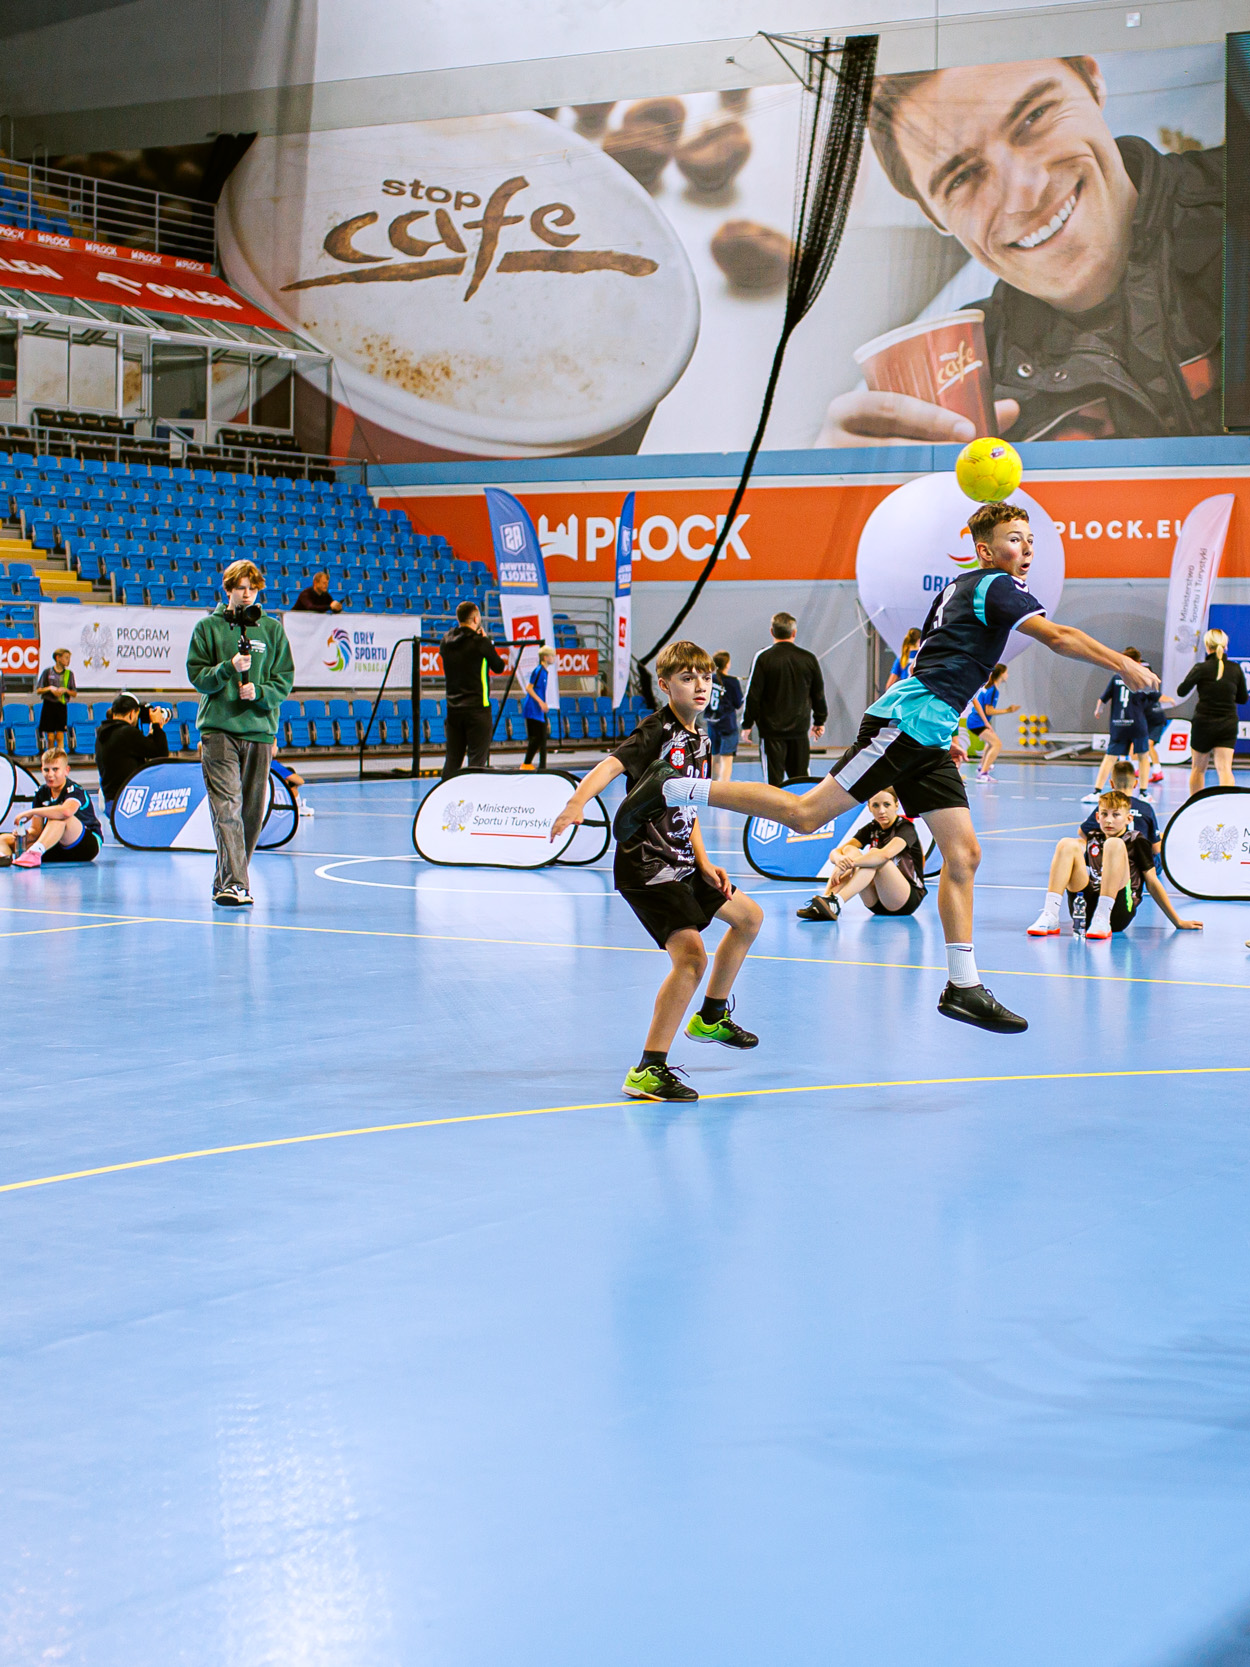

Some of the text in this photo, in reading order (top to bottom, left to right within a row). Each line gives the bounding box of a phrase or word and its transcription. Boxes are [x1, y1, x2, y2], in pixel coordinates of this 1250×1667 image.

[381, 178, 482, 211] stop
[323, 175, 581, 302] cafe
[937, 340, 974, 384] cafe
[1179, 564, 1195, 622] Ministerstwo
[116, 627, 170, 641] PROGRAM
[116, 645, 171, 660] RZĄDOWY
[354, 647, 388, 661] SPORTU
[557, 653, 590, 672] ŁOCK
[1119, 685, 1130, 708] 4
[1100, 738, 1106, 748] 2
[150, 787, 192, 801] AKTYWNA
[147, 796, 189, 812] SZKOŁA
[476, 803, 536, 815] Ministerstwo
[472, 815, 503, 827] Sportu
[510, 816, 552, 829] Turystyki
